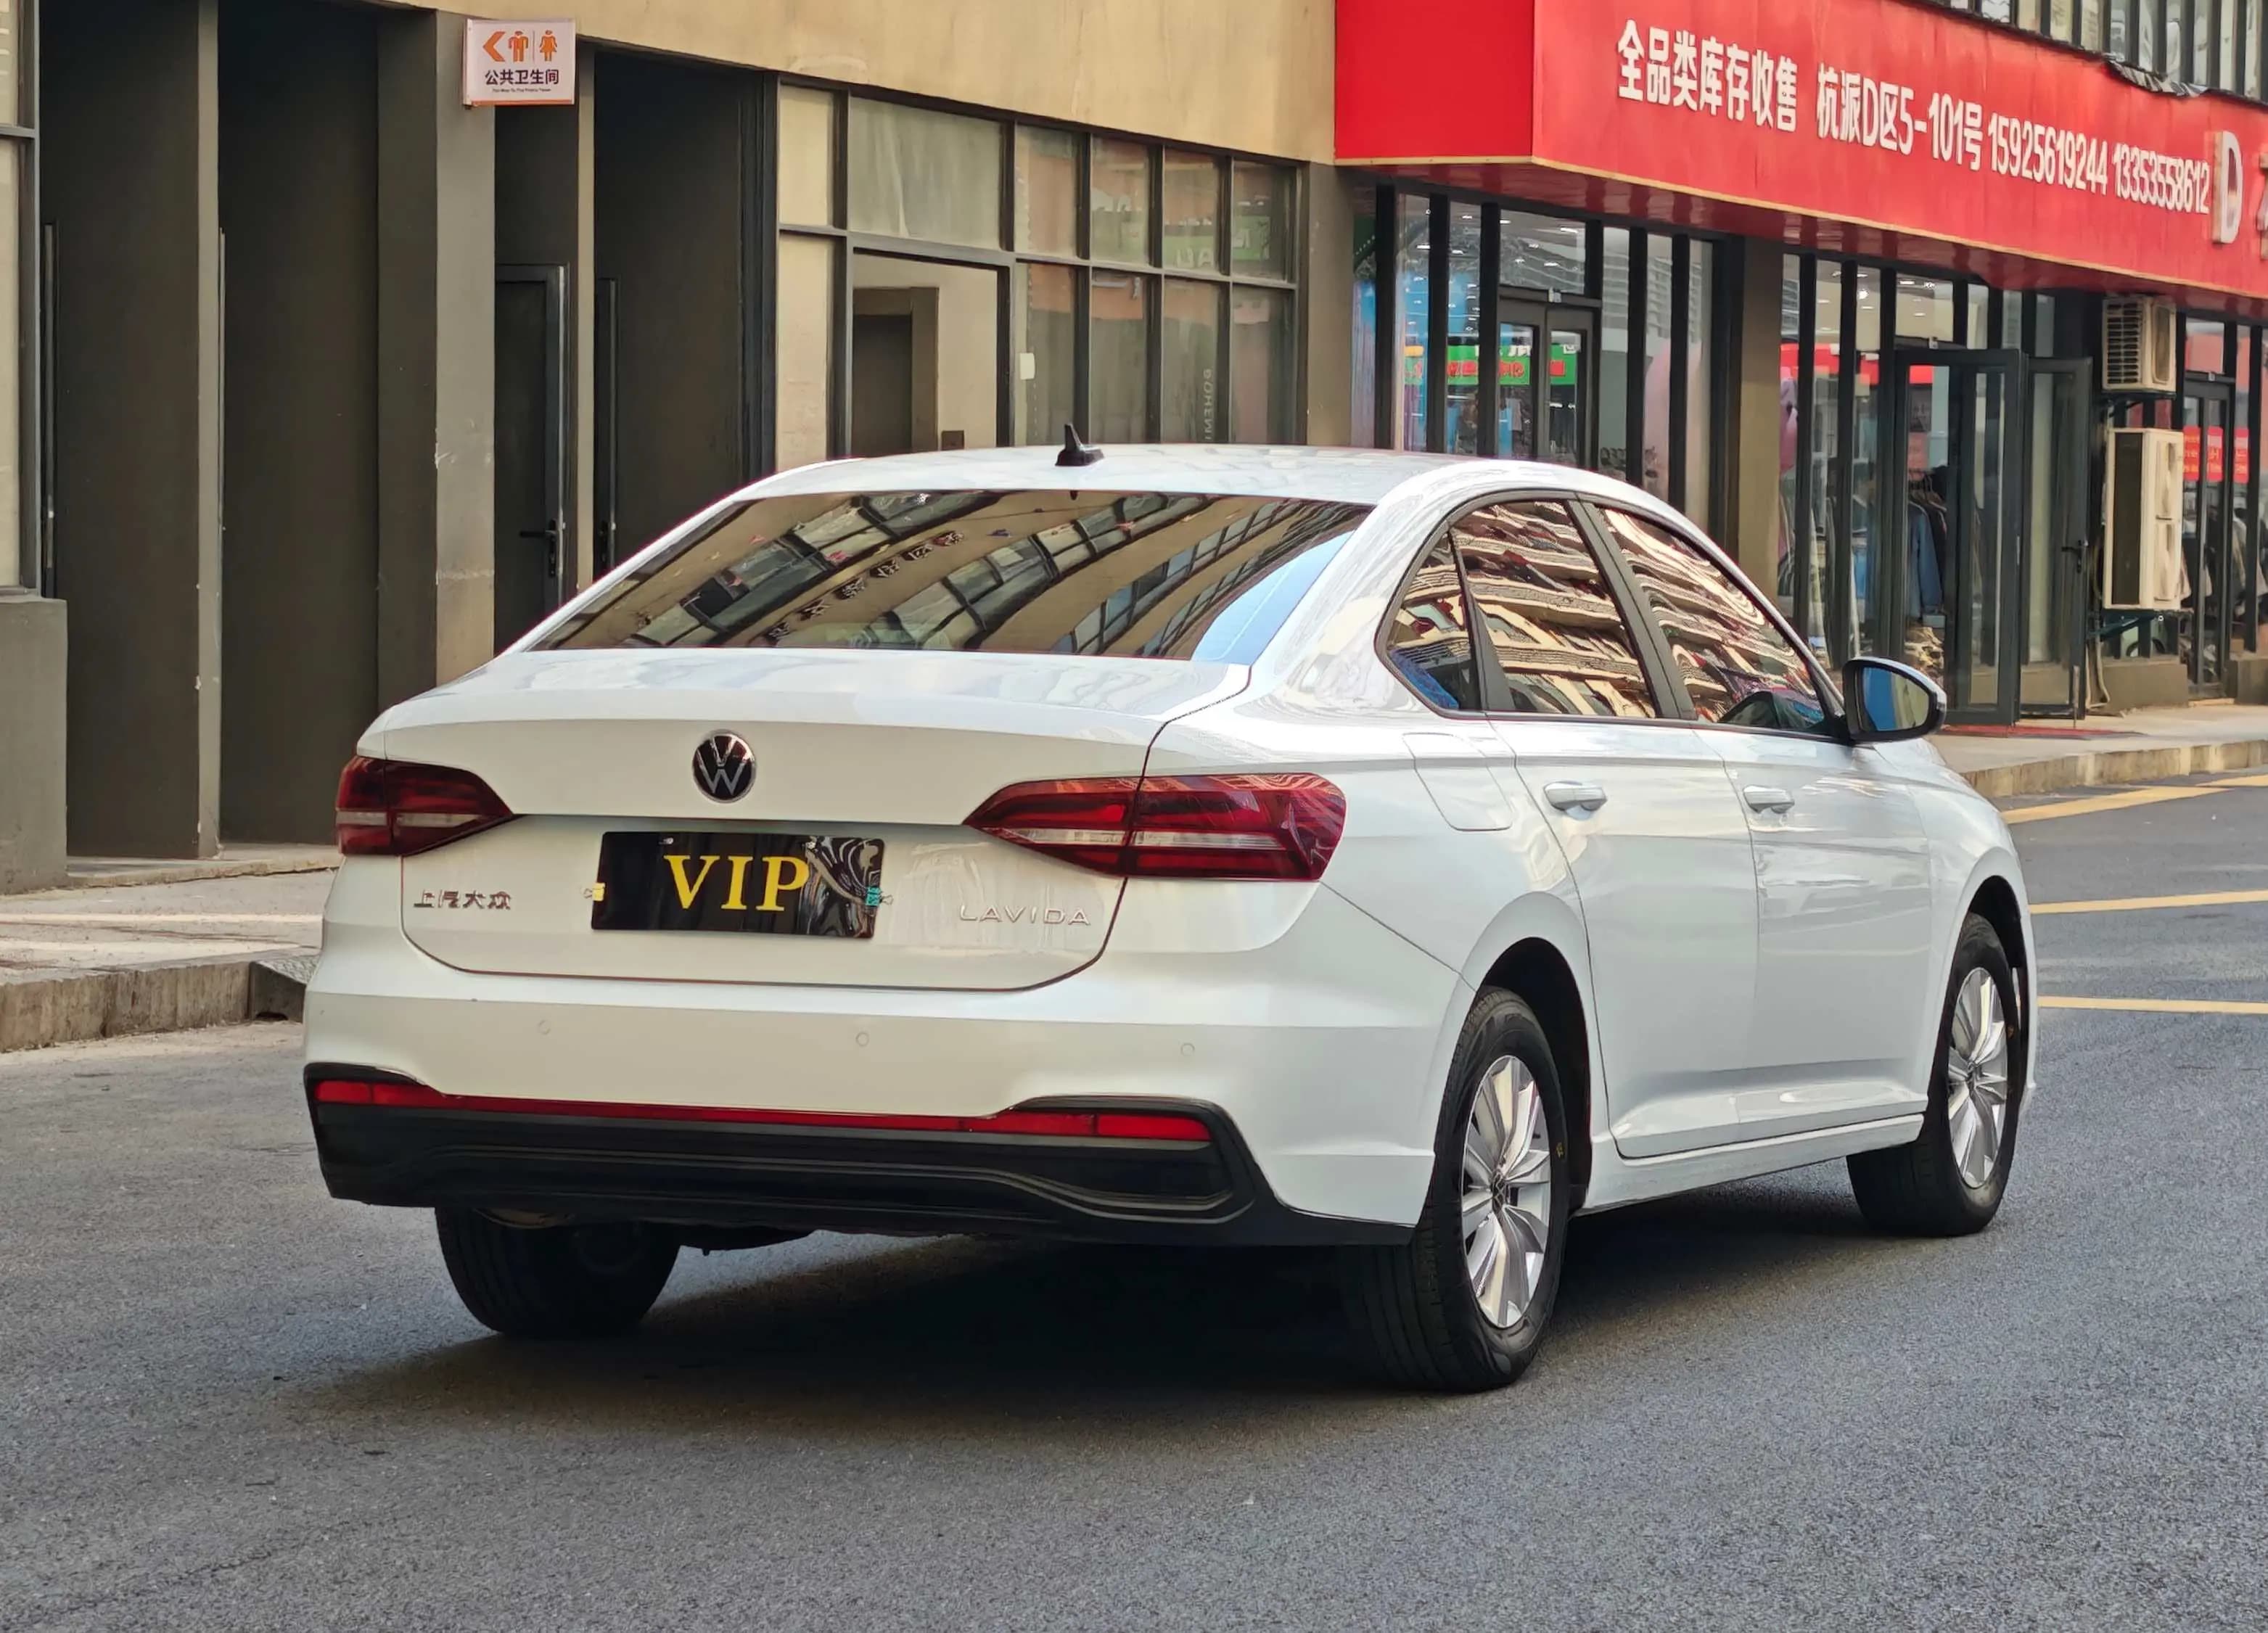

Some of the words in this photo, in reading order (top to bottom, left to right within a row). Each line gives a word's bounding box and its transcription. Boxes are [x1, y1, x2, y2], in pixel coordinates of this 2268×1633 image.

[485, 68, 559, 85] 公共卫生间
[1617, 19, 1798, 132] 全品类库存收售
[1988, 112, 2108, 195] 15925619244
[663, 855, 810, 911] VIP
[959, 905, 1091, 926] LAVIDA
